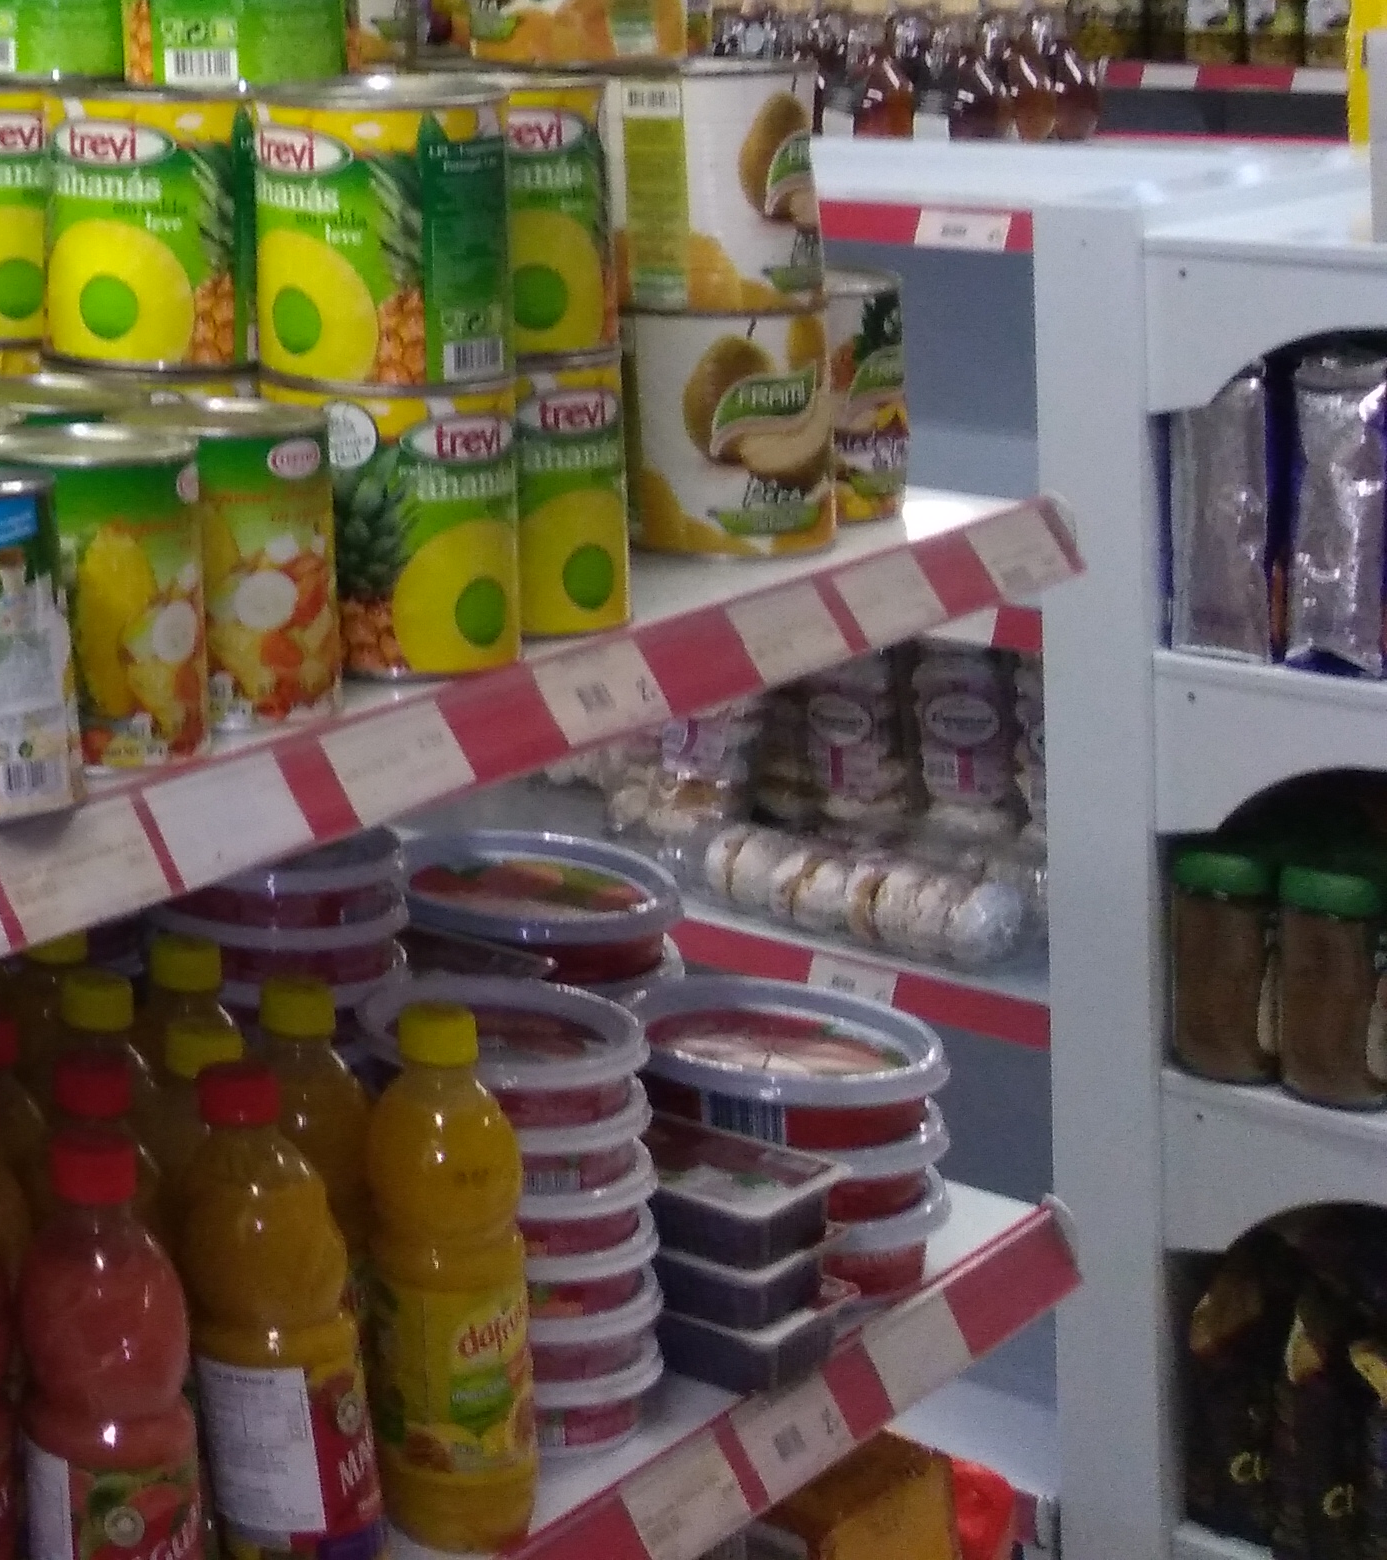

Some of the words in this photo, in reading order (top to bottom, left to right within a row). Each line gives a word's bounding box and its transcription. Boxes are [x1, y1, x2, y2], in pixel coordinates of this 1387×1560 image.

[70, 124, 137, 162] trevi
[259, 130, 314, 171] trevi
[539, 391, 606, 431] trevi
[435, 417, 502, 459] trevi
